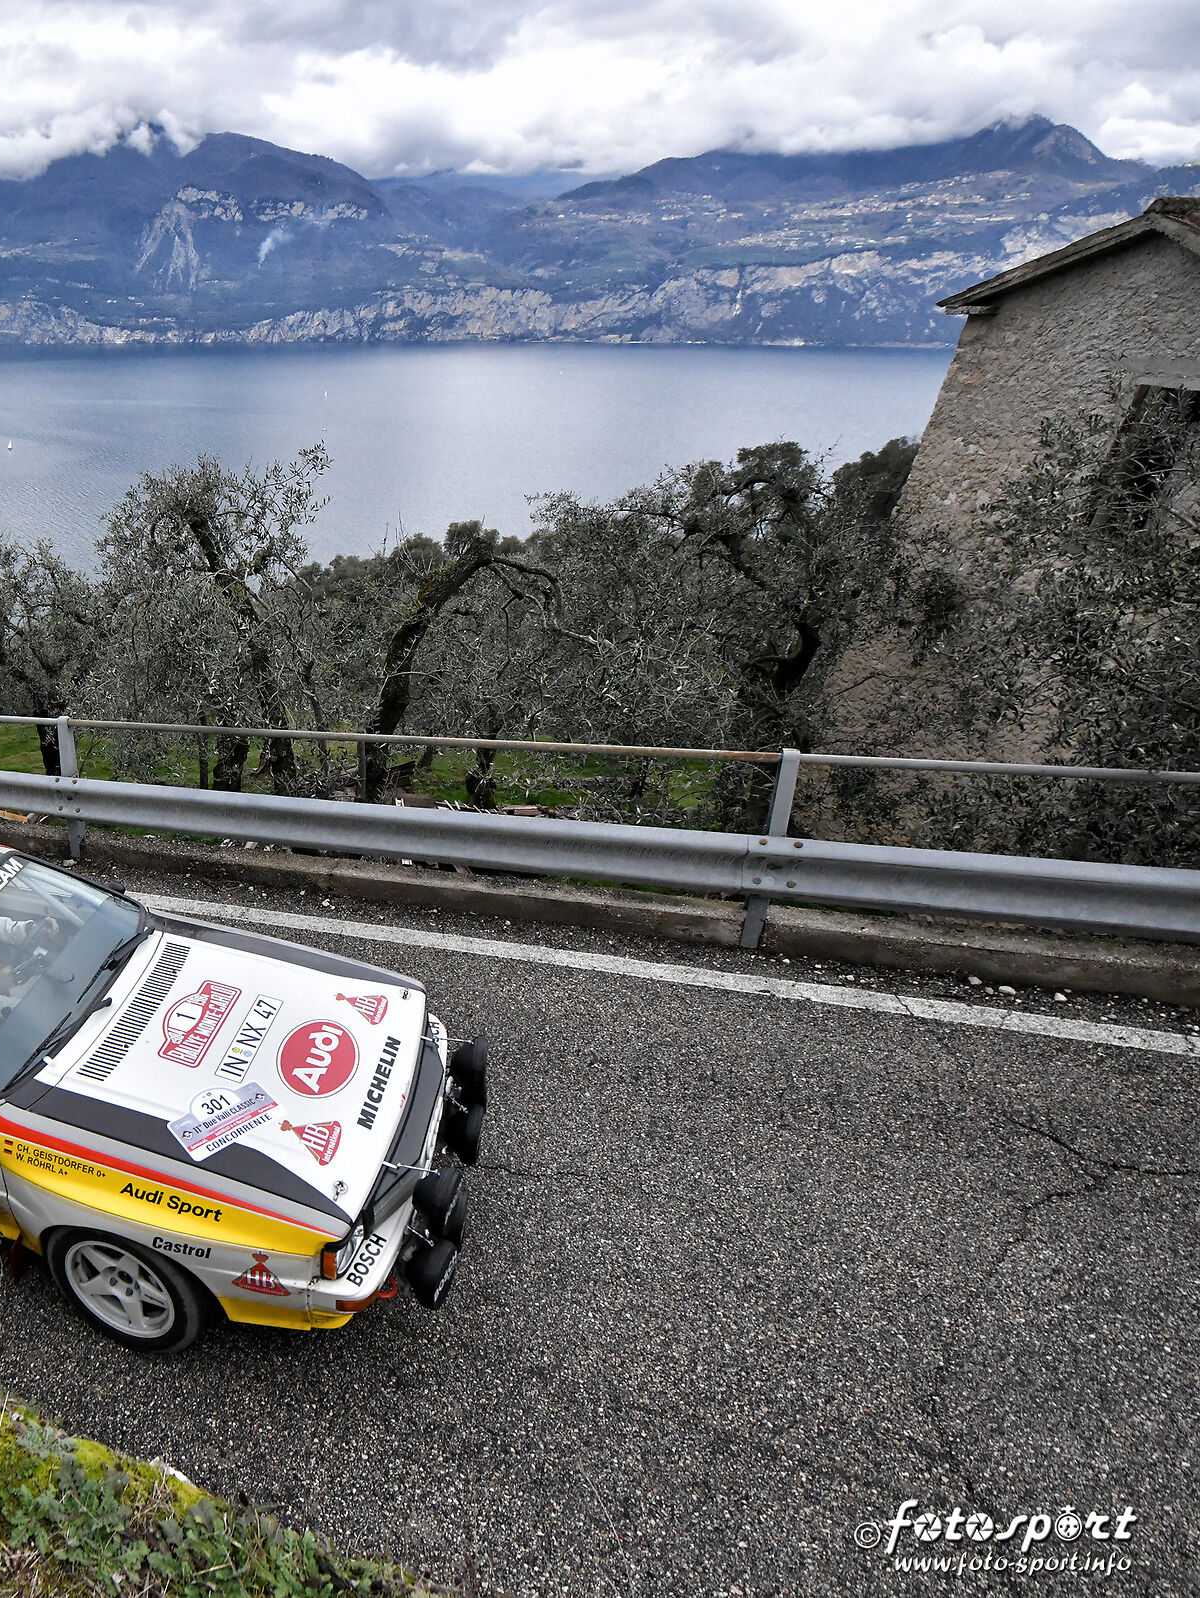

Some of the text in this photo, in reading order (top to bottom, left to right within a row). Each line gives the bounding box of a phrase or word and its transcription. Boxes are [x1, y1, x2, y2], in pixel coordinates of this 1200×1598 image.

[176, 1012, 195, 1020] 1
[253, 1000, 276, 1020] 47
[354, 996, 378, 1016] HB
[167, 1033, 207, 1063] RALLYE
[356, 1036, 401, 1130] MICHELIN
[201, 1094, 230, 1115] 301
[203, 1117, 217, 1128] Due
[215, 1109, 231, 1122] Valli
[229, 1096, 256, 1115] CLASSIC
[206, 1112, 272, 1152] CONCORRENTE
[302, 1124, 330, 1152] HB
[322, 1126, 341, 1163] International
[16, 1144, 30, 1154] CH.
[33, 1148, 94, 1176] GEISTDÖRFER
[16, 1152, 24, 1161] W.
[58, 1168, 68, 1176] A+
[120, 1182, 222, 1222] Audi Sport
[152, 1236, 212, 1259] Castrol
[346, 1233, 387, 1286] BOSCH
[246, 1268, 276, 1289] HB
